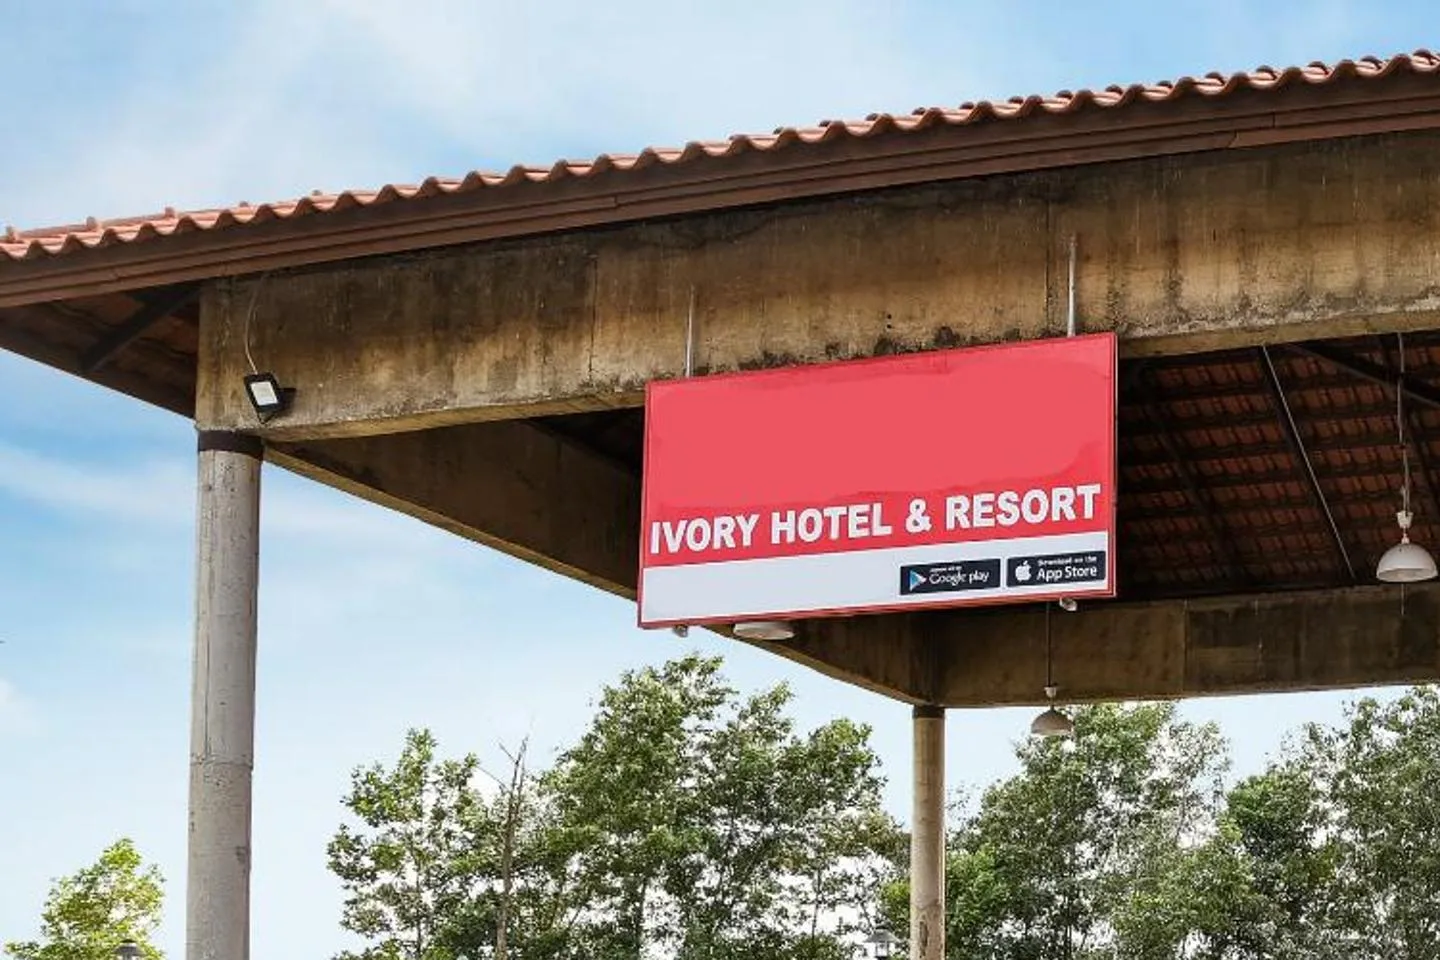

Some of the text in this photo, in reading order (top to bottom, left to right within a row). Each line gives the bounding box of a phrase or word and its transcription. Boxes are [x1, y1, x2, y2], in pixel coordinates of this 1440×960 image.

[650, 483, 1101, 554] IVORY HOTEL & RESORT
[929, 571, 967, 587] Google
[969, 569, 990, 584] play
[1036, 565, 1098, 582] App Store
